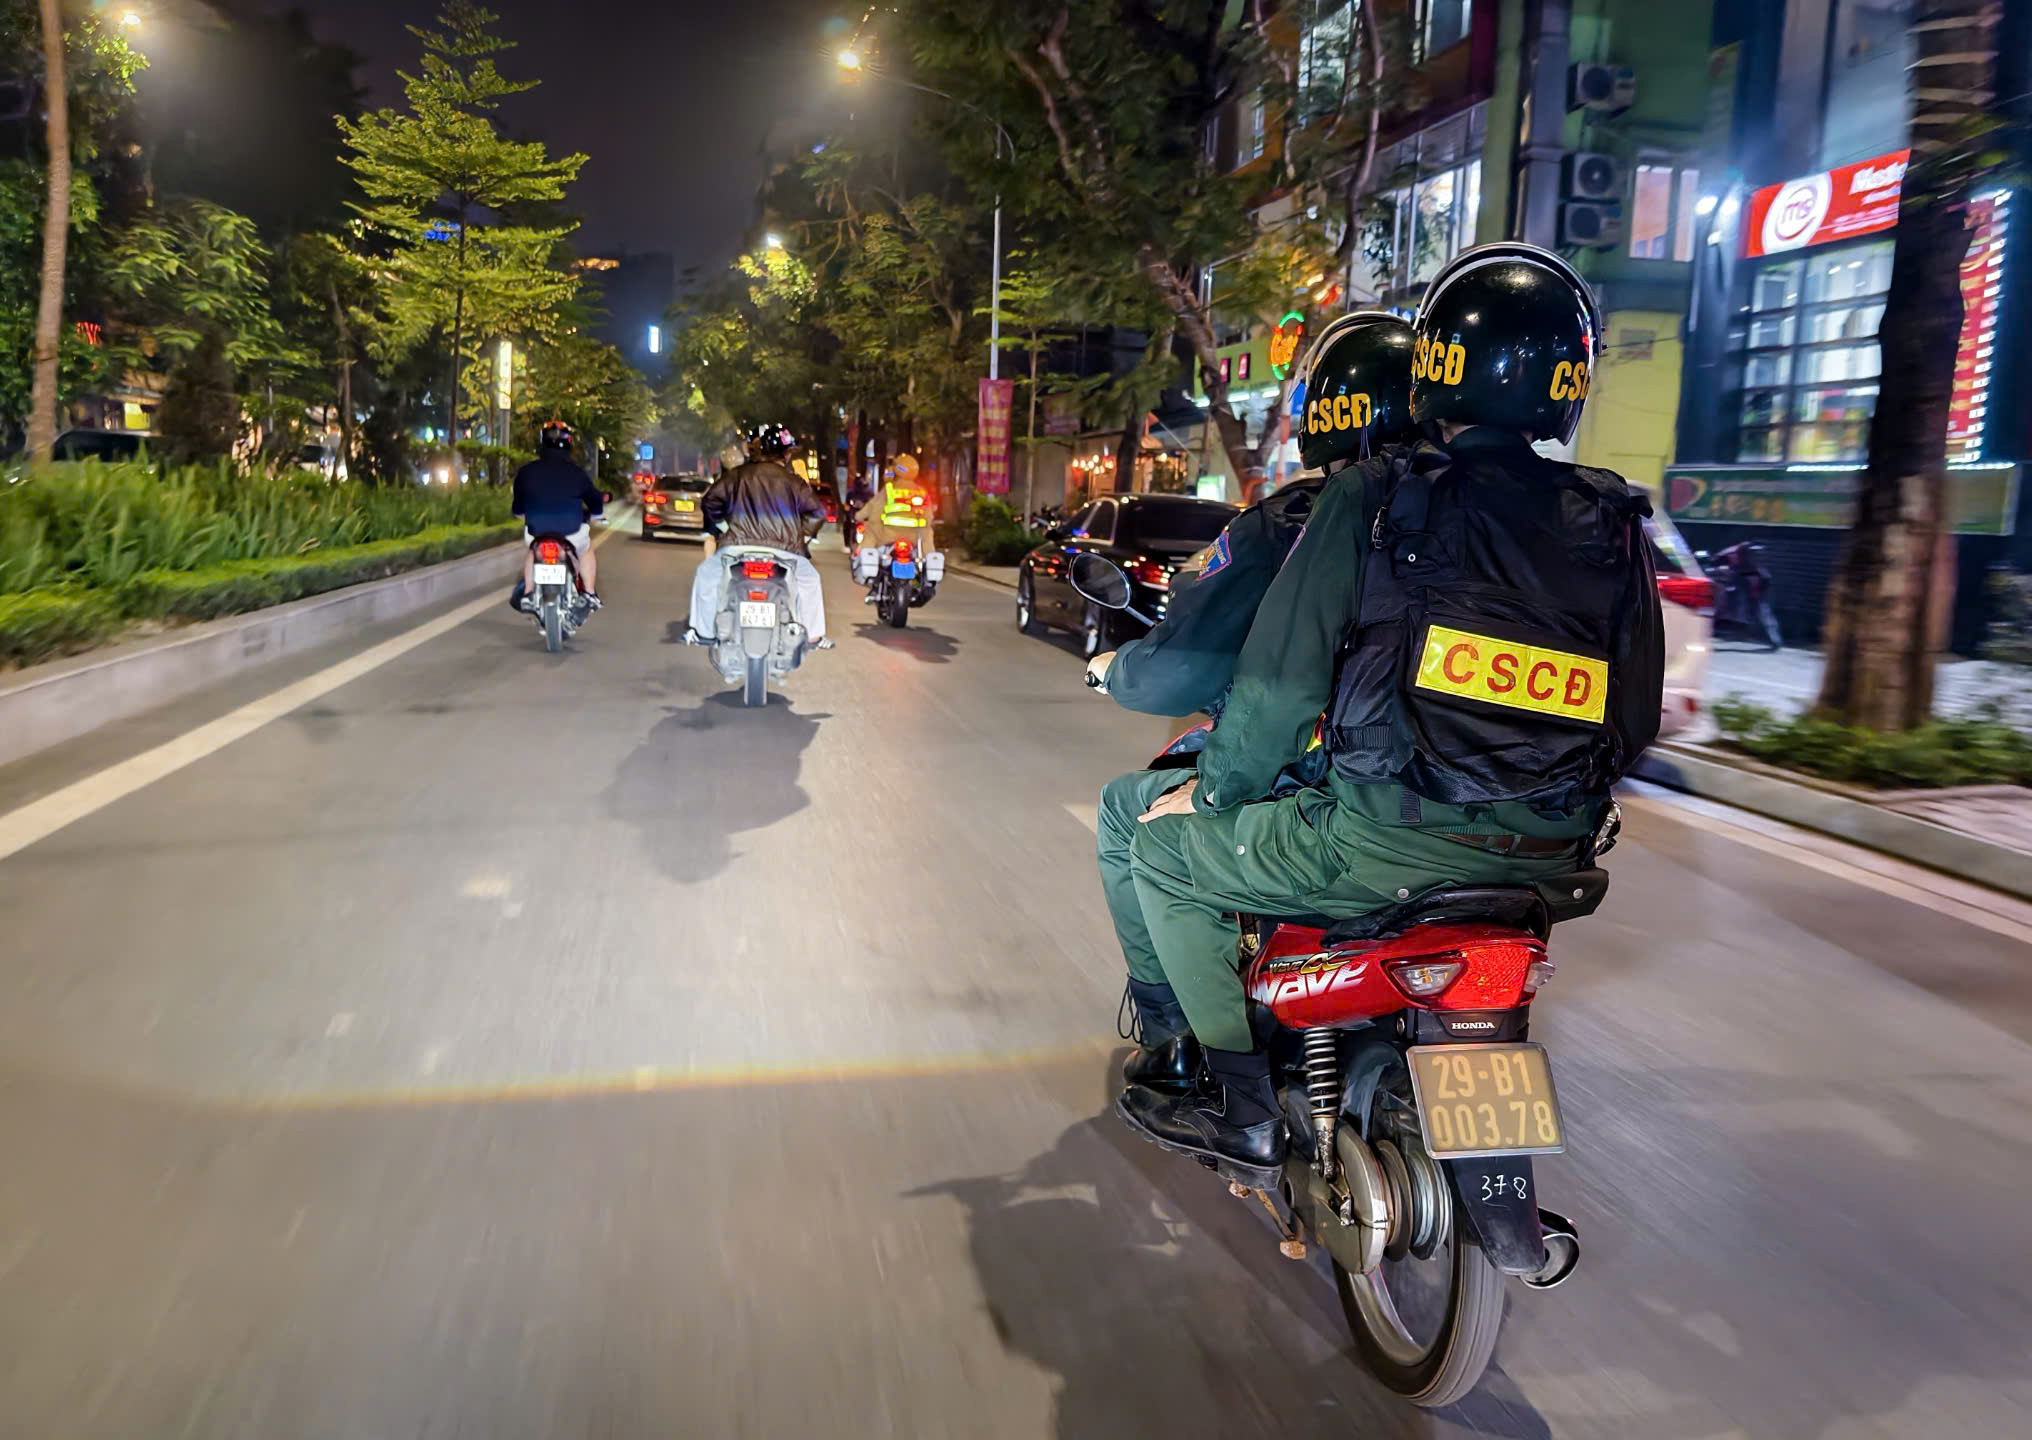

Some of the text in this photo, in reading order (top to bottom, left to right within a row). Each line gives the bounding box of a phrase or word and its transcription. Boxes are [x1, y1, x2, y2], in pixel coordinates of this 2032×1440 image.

[1442, 643, 1592, 707] CSCĐ
[1451, 1021, 1496, 1030] HONDA
[1431, 1052, 1533, 1099] 29-B1
[1430, 1101, 1557, 1148] 003.78
[1481, 1174, 1527, 1201] 378
